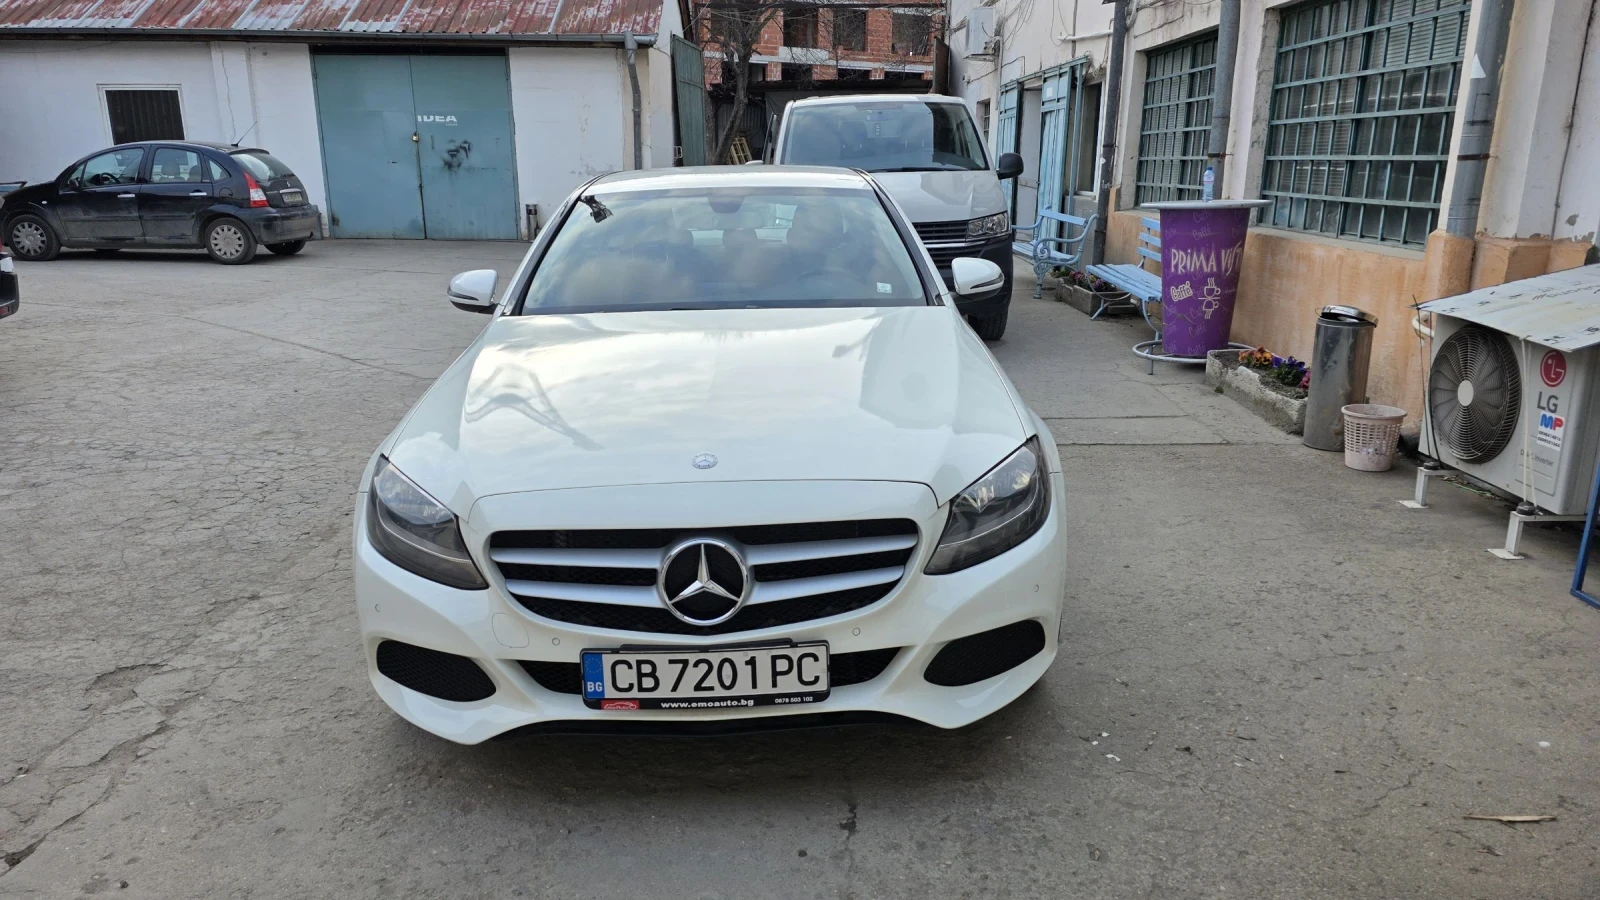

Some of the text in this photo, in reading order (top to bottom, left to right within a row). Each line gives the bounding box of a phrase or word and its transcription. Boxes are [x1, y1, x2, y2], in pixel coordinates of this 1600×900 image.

[1537, 391, 1559, 414] LG
[1540, 413, 1565, 431] MP
[587, 681, 603, 692] BG
[661, 698, 754, 709] www.emoauto.bg
